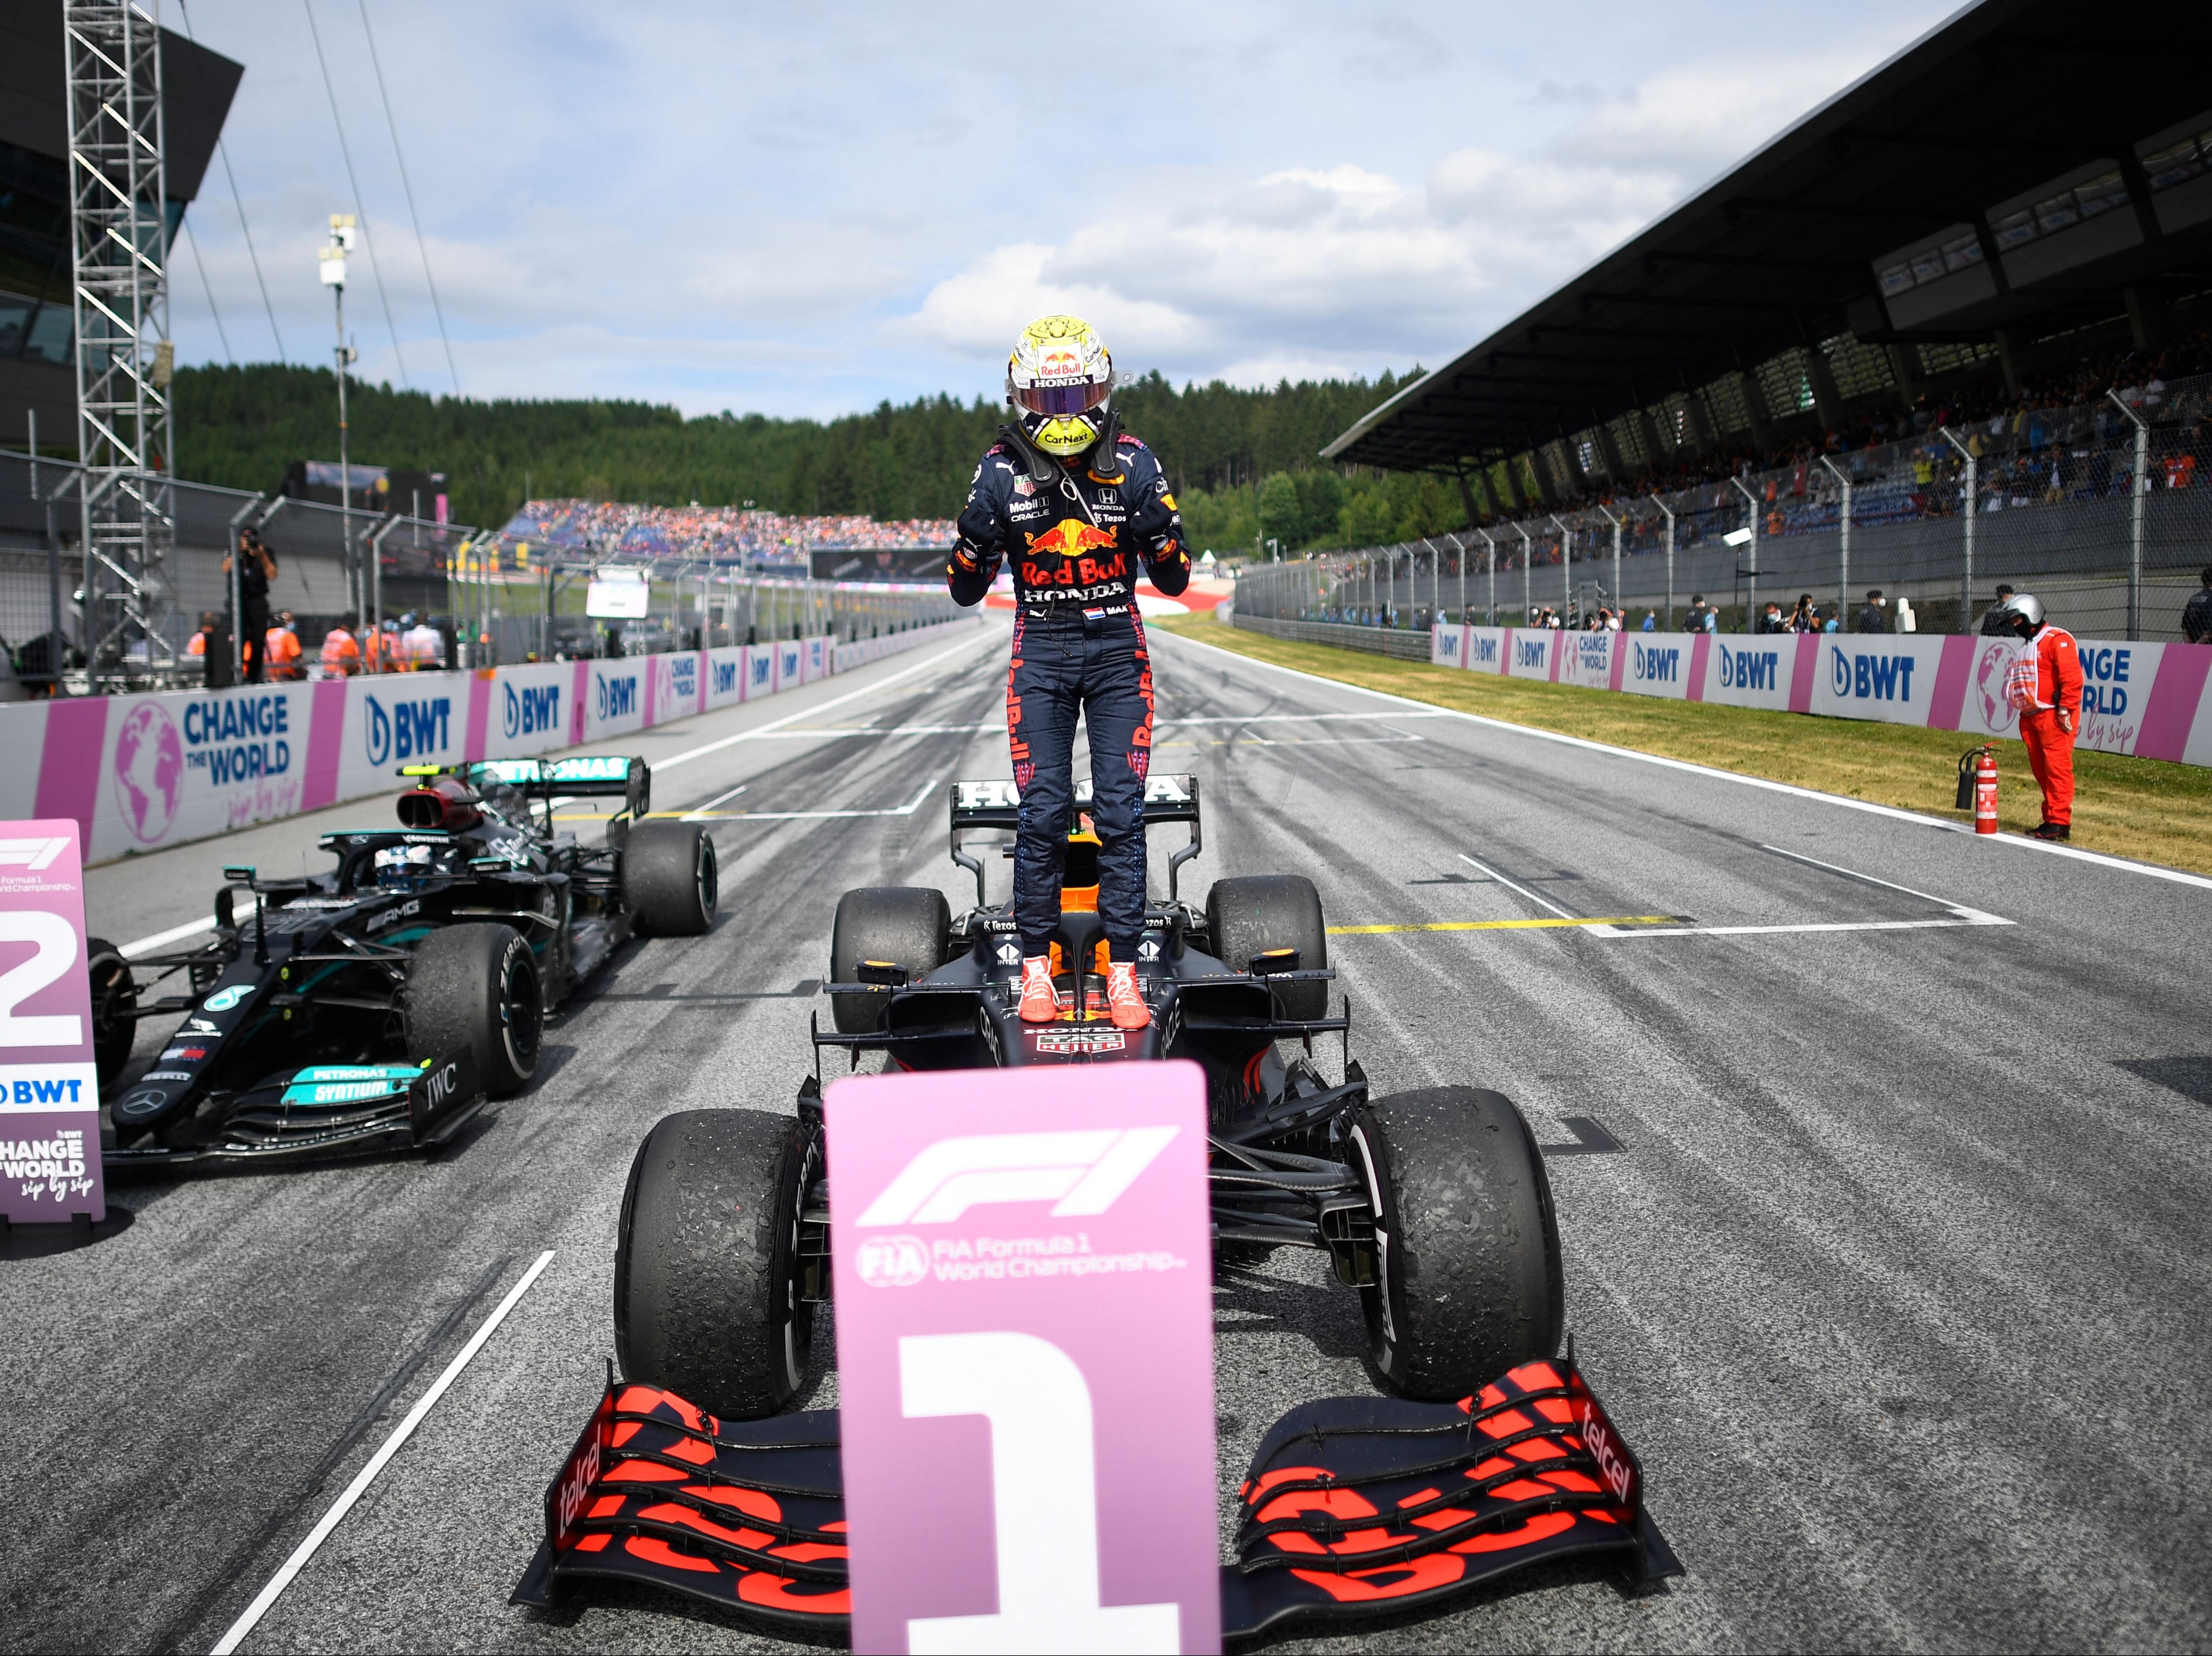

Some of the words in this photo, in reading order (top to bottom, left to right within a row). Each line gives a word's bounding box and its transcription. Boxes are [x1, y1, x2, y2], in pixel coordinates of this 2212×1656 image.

[1034, 377, 1089, 387] HONDA
[1042, 365, 1060, 376] Red
[1062, 363, 1081, 374] Bull
[1044, 433, 1088, 444] CarNext
[1016, 474, 1031, 485] TA
[1016, 485, 1036, 494] HEUE
[1009, 499, 1038, 513] Mobil
[1011, 509, 1050, 522] ORACLE
[1104, 514, 1126, 522] Tezos
[1021, 559, 1074, 586] Red
[1078, 552, 1127, 585] Bull
[1024, 582, 1127, 602] HONDA
[1106, 604, 1129, 615] MAX
[1444, 635, 1458, 657] BWT
[1480, 638, 1496, 663] BWT
[1525, 641, 1545, 668] BWT
[1579, 635, 1607, 652] CHANGE
[671, 658, 694, 677] CHANGE
[1585, 655, 1607, 670] WORLD
[1647, 648, 1680, 682] BWT
[1736, 651, 1778, 690] BWT
[2079, 648, 2131, 682] NGE
[719, 662, 735, 692] BWT
[1855, 654, 1914, 702] BWT
[609, 677, 637, 717] BWT
[2082, 684, 2127, 716] RLD
[184, 695, 288, 745] CHANGE
[522, 685, 559, 735] BWT
[394, 697, 450, 759] BWT
[2108, 719, 2133, 753] sip
[187, 750, 207, 769] THE
[208, 740, 290, 786] WORLD
[485, 758, 624, 781] PETONAS
[383, 899, 420, 925] AMG
[1146, 919, 1164, 927] ezos
[992, 920, 1017, 931] Tezos
[0, 910, 83, 1048] 2
[980, 1006, 1002, 1069] ORAC
[1161, 998, 1180, 1062] RACLE
[314, 1068, 386, 1080] PETRONAS
[426, 1062, 456, 1110] IWC
[13, 1079, 82, 1104] BWT
[64, 1130, 83, 1139] BWT
[0, 1139, 84, 1160] HANGE
[3, 1159, 85, 1178] WORLD
[21, 1180, 45, 1202] sip
[49, 1173, 66, 1203] by
[70, 1176, 94, 1197] sip
[863, 1245, 922, 1279] FIA
[933, 1240, 973, 1259] FIA
[979, 1235, 1074, 1258] Formula
[1077, 1232, 1091, 1253] 1
[934, 1258, 1002, 1282] World
[1582, 1401, 1632, 1505] telcel
[559, 1422, 601, 1539] telcel
[899, 1331, 1181, 1655] 1
